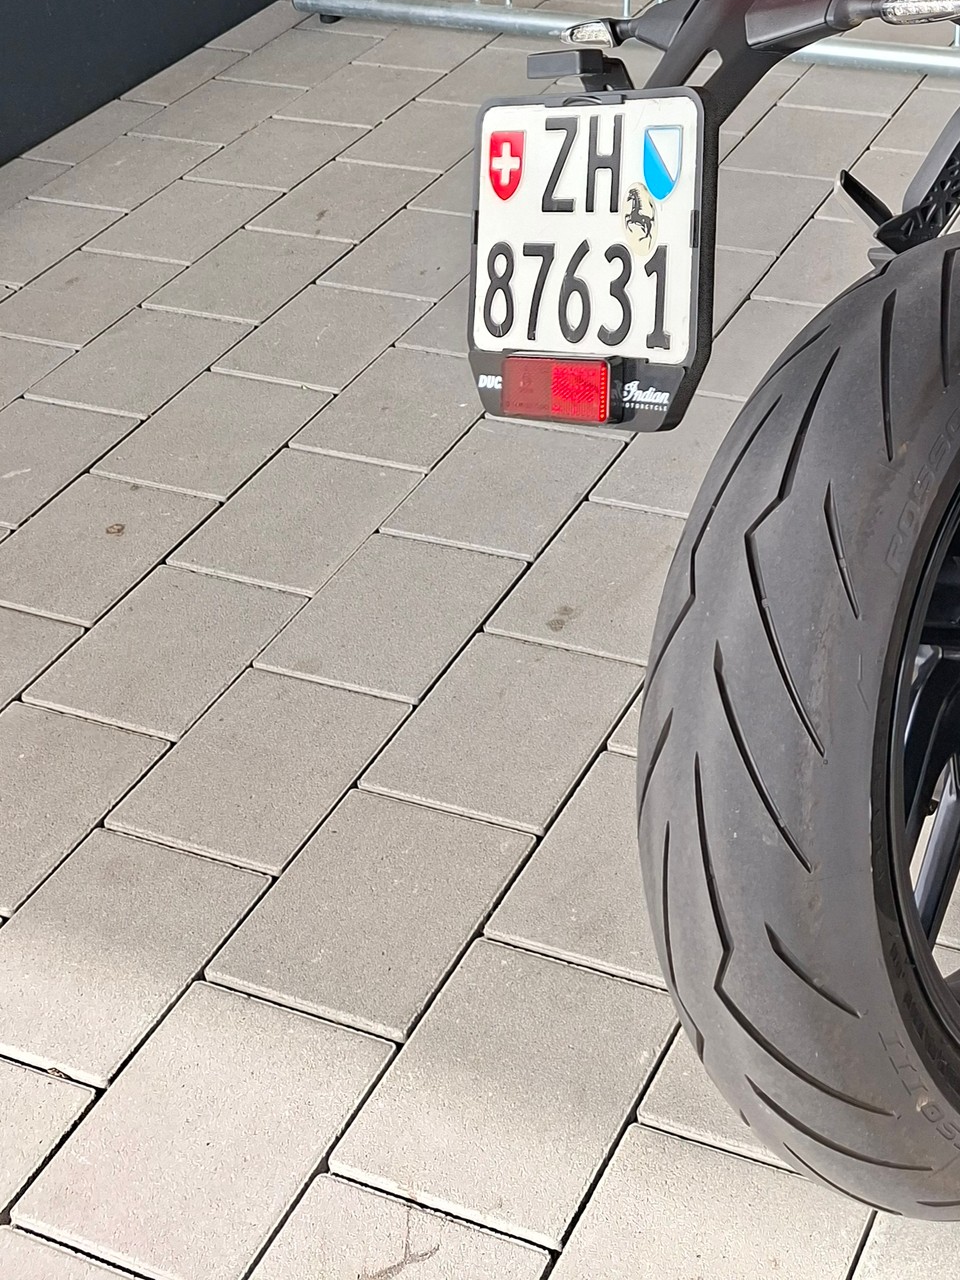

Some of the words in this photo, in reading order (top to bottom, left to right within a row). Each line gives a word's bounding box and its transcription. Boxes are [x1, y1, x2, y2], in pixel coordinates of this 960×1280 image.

[542, 114, 623, 213] ZH
[484, 239, 671, 350] 87631
[621, 402, 668, 412] OTORCYCLE
[622, 380, 670, 405] Indian
